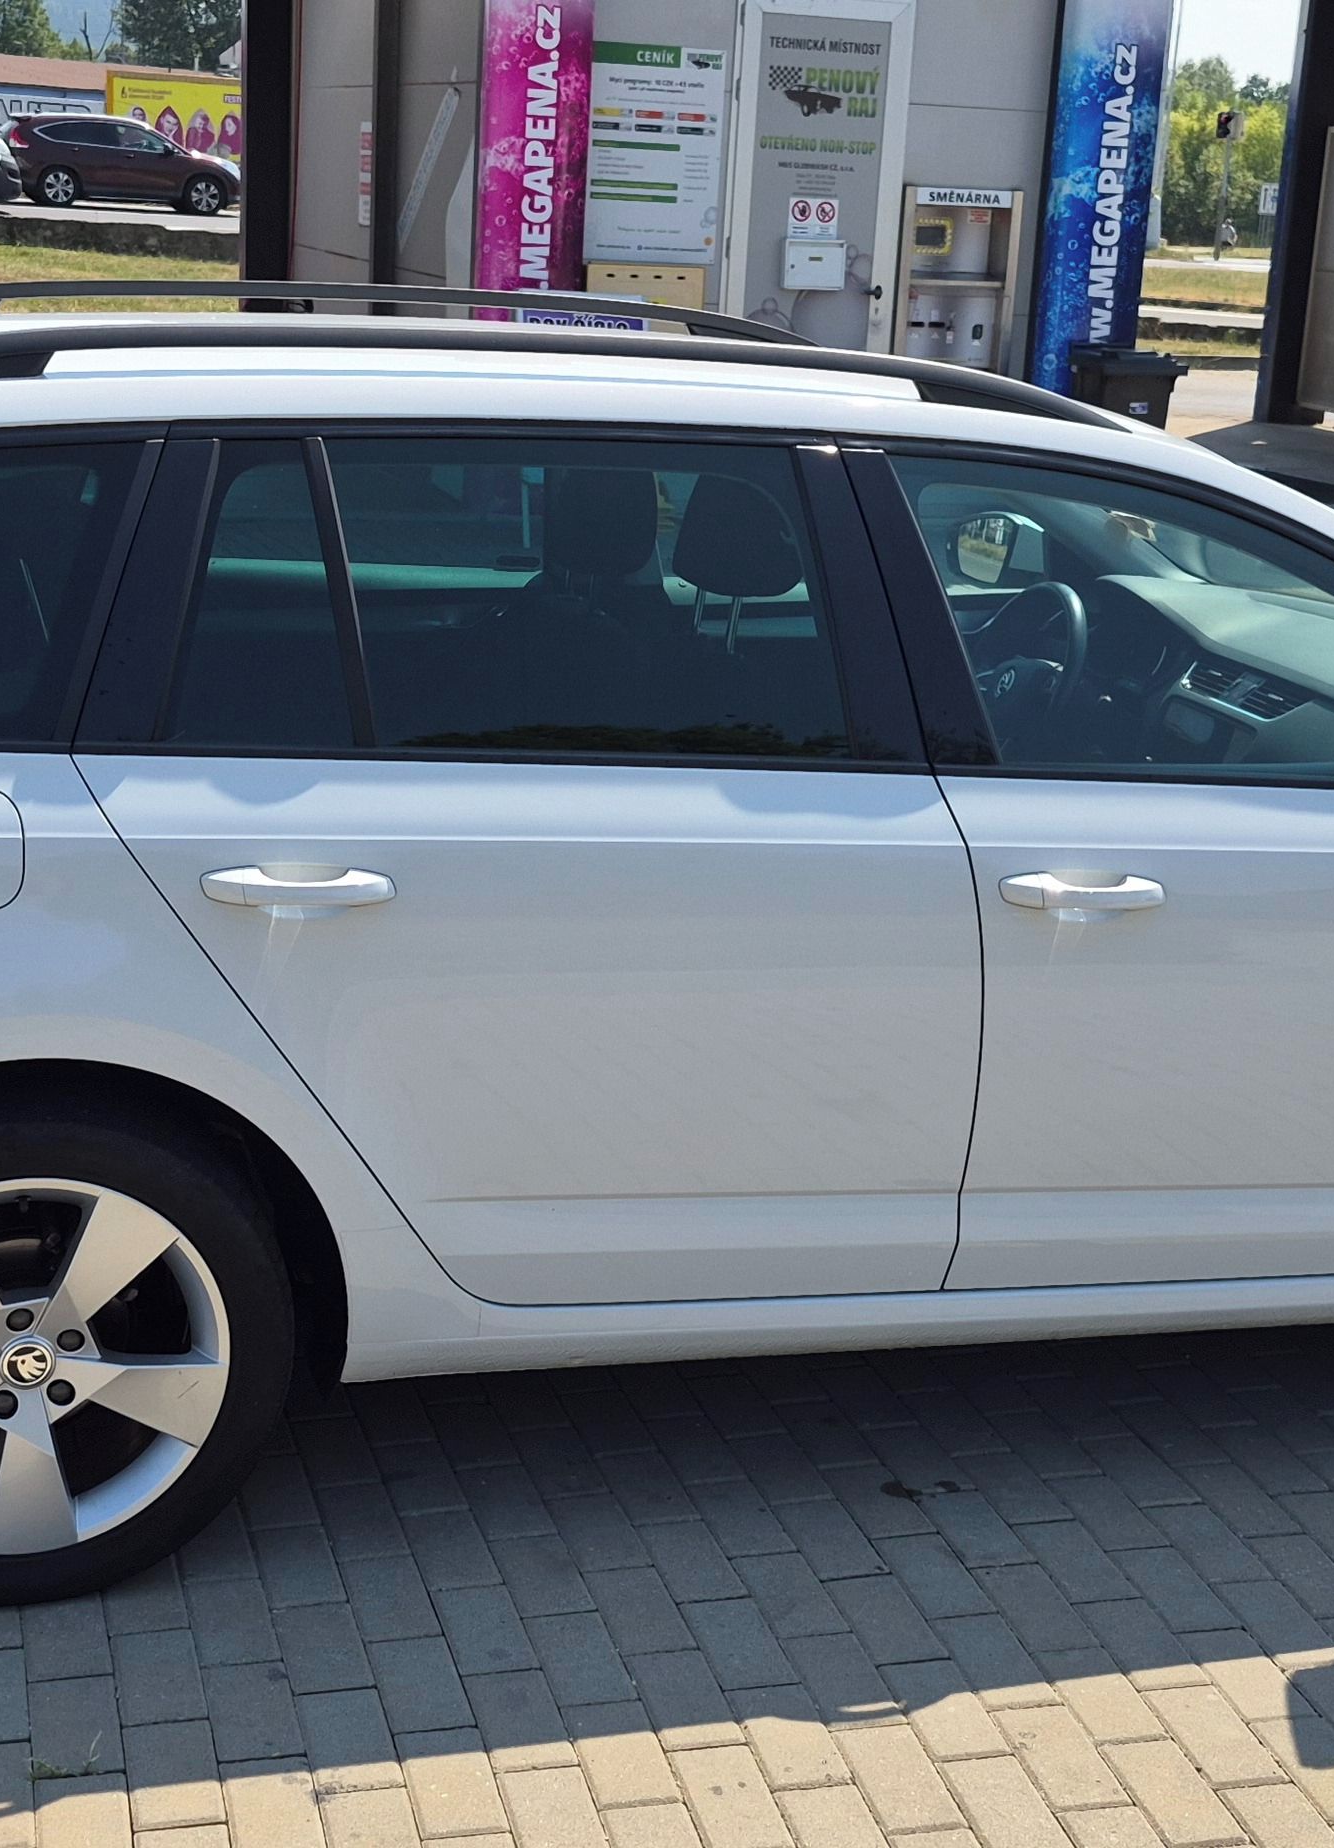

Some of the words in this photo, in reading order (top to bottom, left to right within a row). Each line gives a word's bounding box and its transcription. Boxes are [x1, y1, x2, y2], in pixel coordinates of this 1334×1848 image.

[769, 36, 826, 52] TECHNICKÁ
[828, 39, 881, 55] MÍSTNOST
[636, 50, 675, 64] CENÍK
[760, 134, 817, 152] OTEVŘENO
[819, 139, 876, 155] NON-STOP
[928, 191, 1001, 205] SMĚNÁRNA
